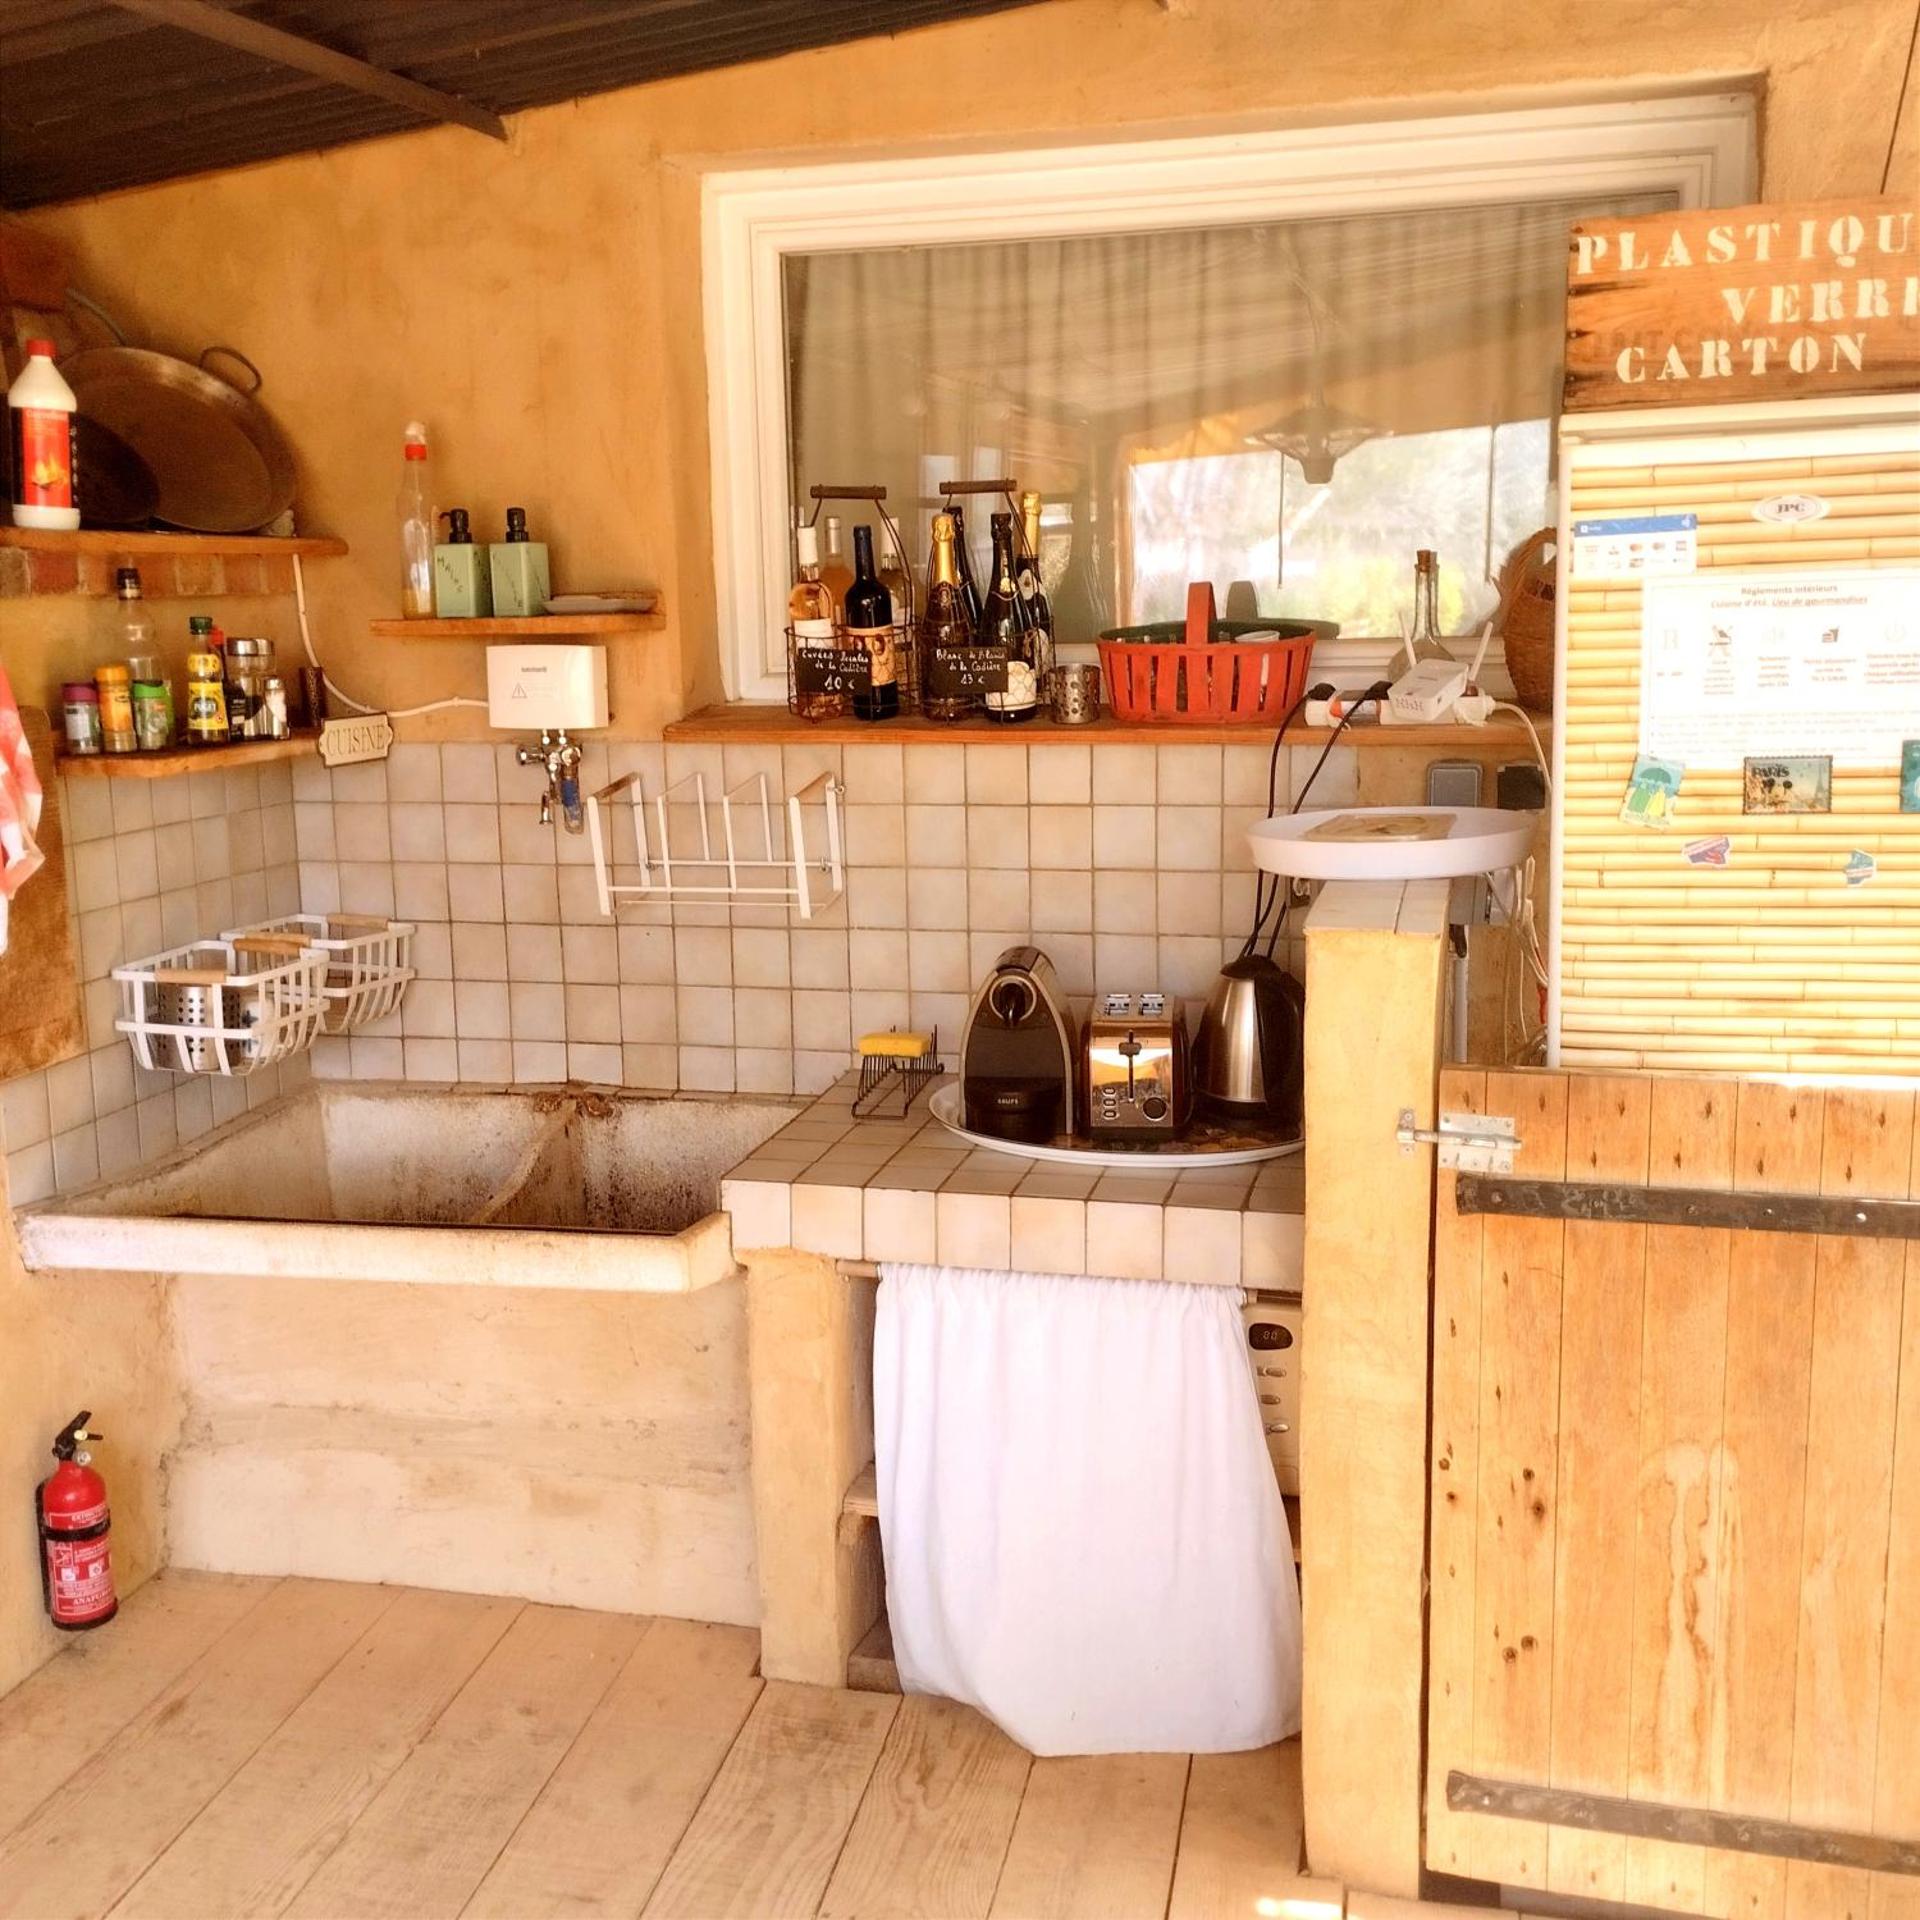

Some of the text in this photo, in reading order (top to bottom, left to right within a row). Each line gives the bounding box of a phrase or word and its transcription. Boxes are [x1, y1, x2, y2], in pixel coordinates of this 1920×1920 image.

[1577, 213, 1914, 275] PLASTIQU
[1616, 332, 1868, 384] CARTON
[824, 673, 843, 691] 10
[326, 724, 385, 757] CUISINE
